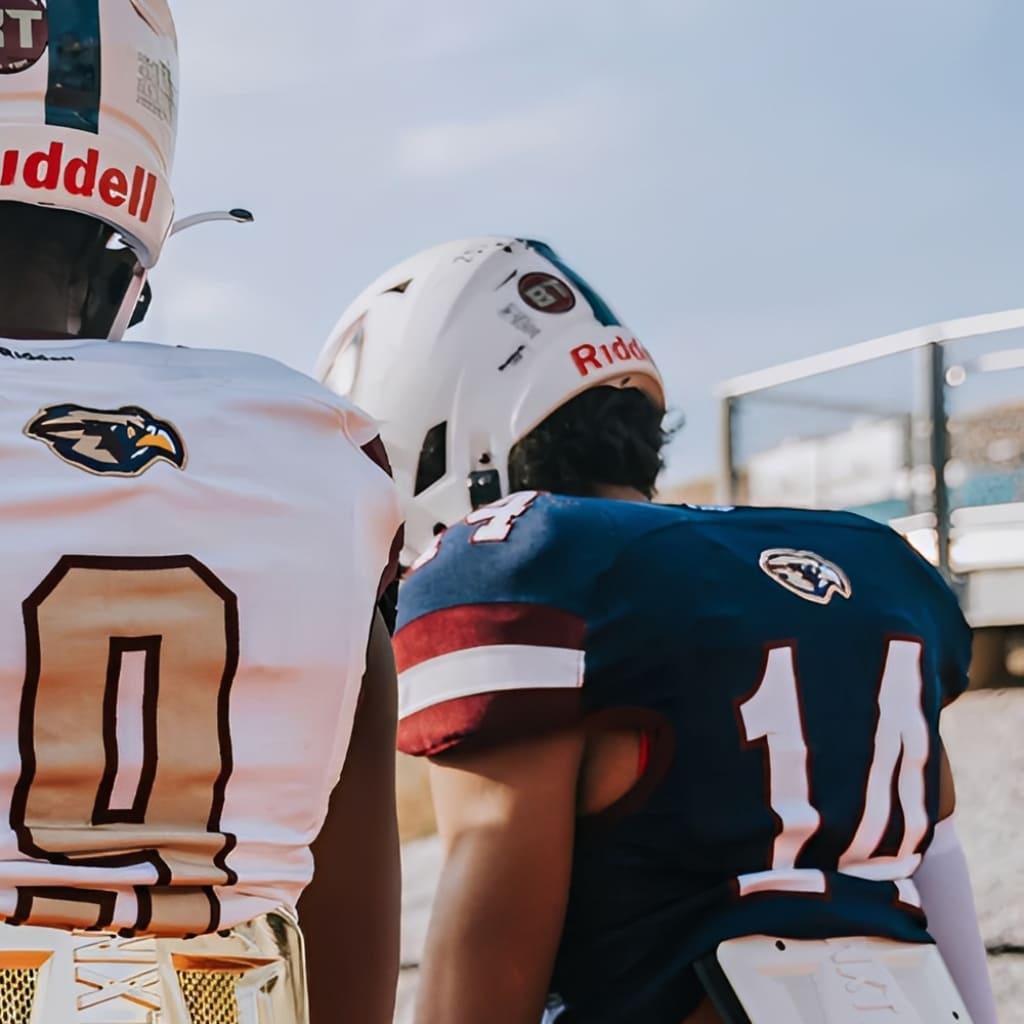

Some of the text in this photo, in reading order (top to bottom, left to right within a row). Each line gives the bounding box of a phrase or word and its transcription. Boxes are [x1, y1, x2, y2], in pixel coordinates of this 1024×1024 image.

[525, 278, 570, 308] BT
[570, 335, 652, 377] Ridd
[733, 636, 931, 909] 14
